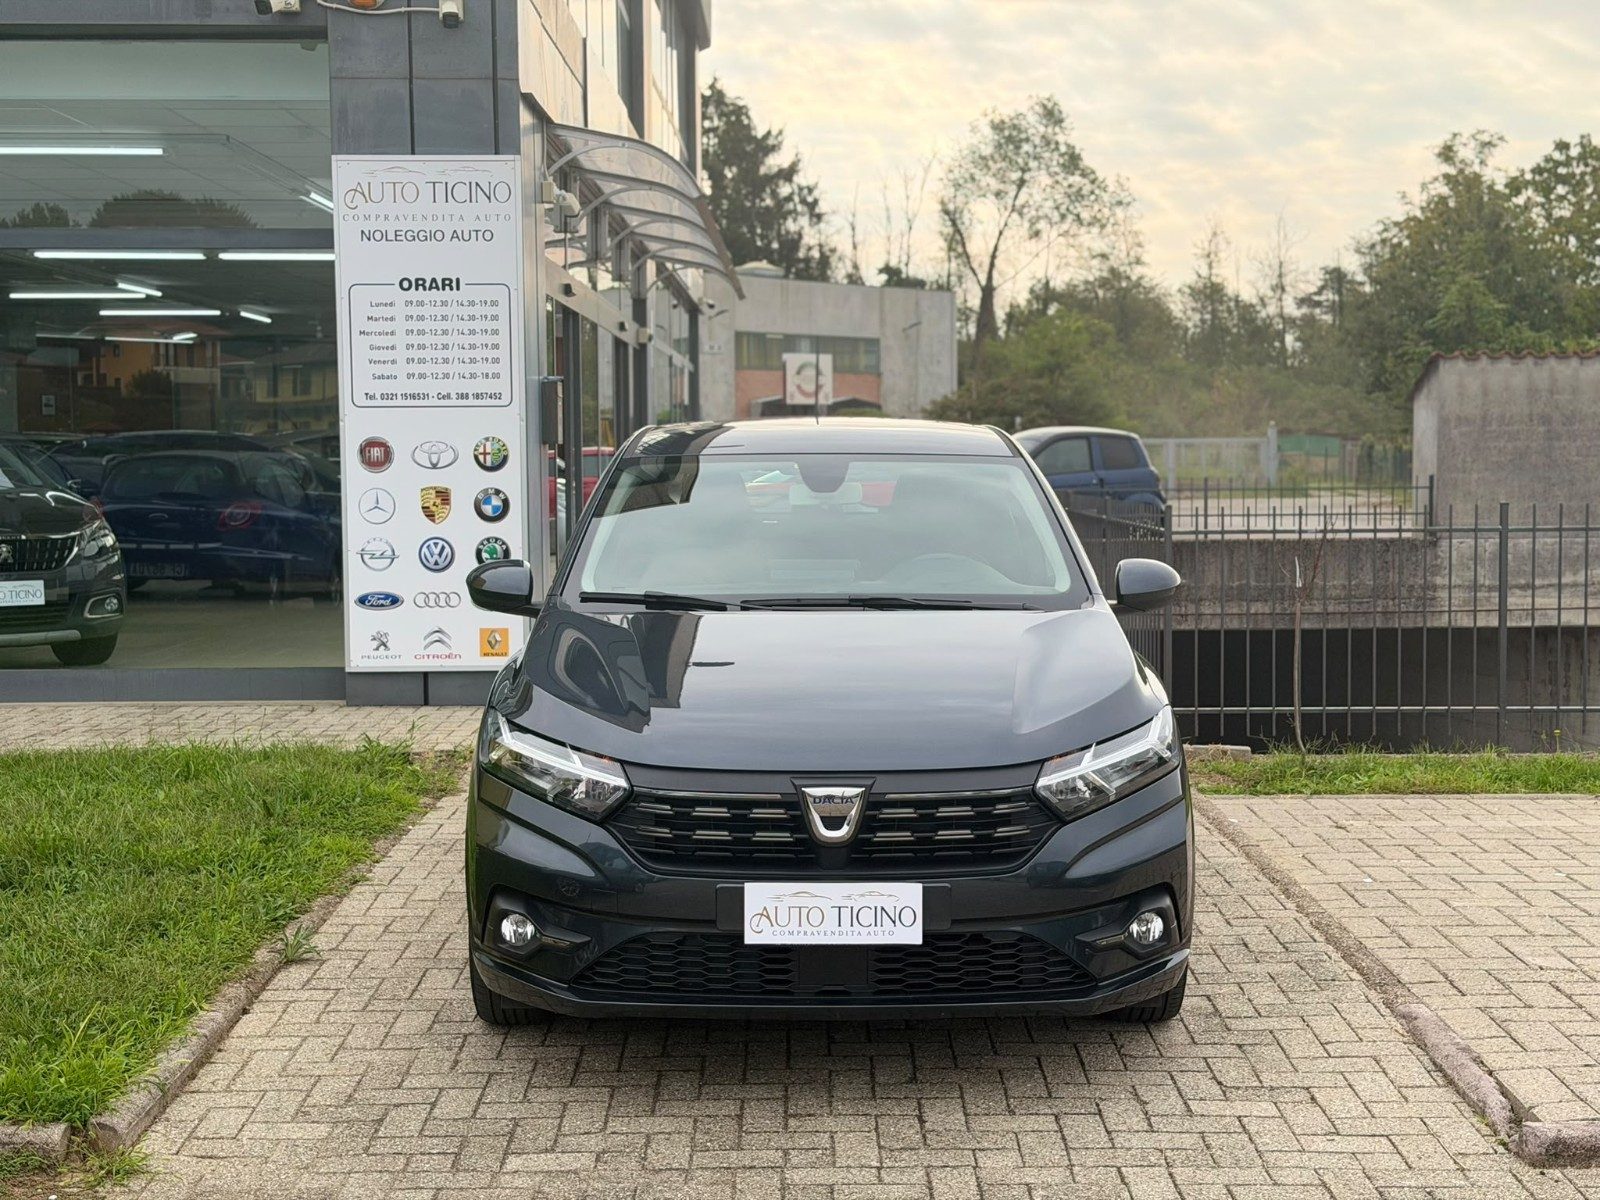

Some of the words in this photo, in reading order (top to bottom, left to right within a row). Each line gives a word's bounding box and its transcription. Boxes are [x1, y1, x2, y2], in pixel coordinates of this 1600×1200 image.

[344, 181, 420, 210] AUTO
[425, 181, 512, 204] TICINO
[342, 213, 465, 222] COMPRAVENDITA
[475, 213, 512, 222] AUTO
[360, 229, 445, 242] NOLEGGIO
[450, 229, 494, 242] AUTO
[399, 277, 461, 292] ORARI
[405, 314, 449, 322] 09.00-12.30
[456, 314, 500, 322] 14.30-19.00
[405, 328, 450, 336] 09.00-12.30
[456, 328, 500, 336] 14.30-19.00
[405, 343, 450, 351] 09.00-12.30
[457, 343, 500, 351] 14.30-19.00
[406, 357, 450, 365] 09.00-12.30
[457, 357, 501, 365] 14.30-19.00
[406, 372, 451, 380] 09.00-12.30
[457, 372, 501, 380] 14.30-18.00
[364, 392, 379, 401] Tel.
[380, 392, 398, 401] 0321
[400, 392, 430, 401] 1516531
[436, 392, 454, 401] Cell.
[455, 392, 470, 401] 388
[471, 392, 502, 401] 1857452
[365, 447, 386, 462] FIAT
[477, 488, 507, 500] BMW
[8, 588, 43, 600] TICINO
[365, 594, 392, 606] Ford
[813, 795, 855, 805] DACIA
[749, 905, 825, 934] AUTO
[830, 905, 917, 928] TICINO
